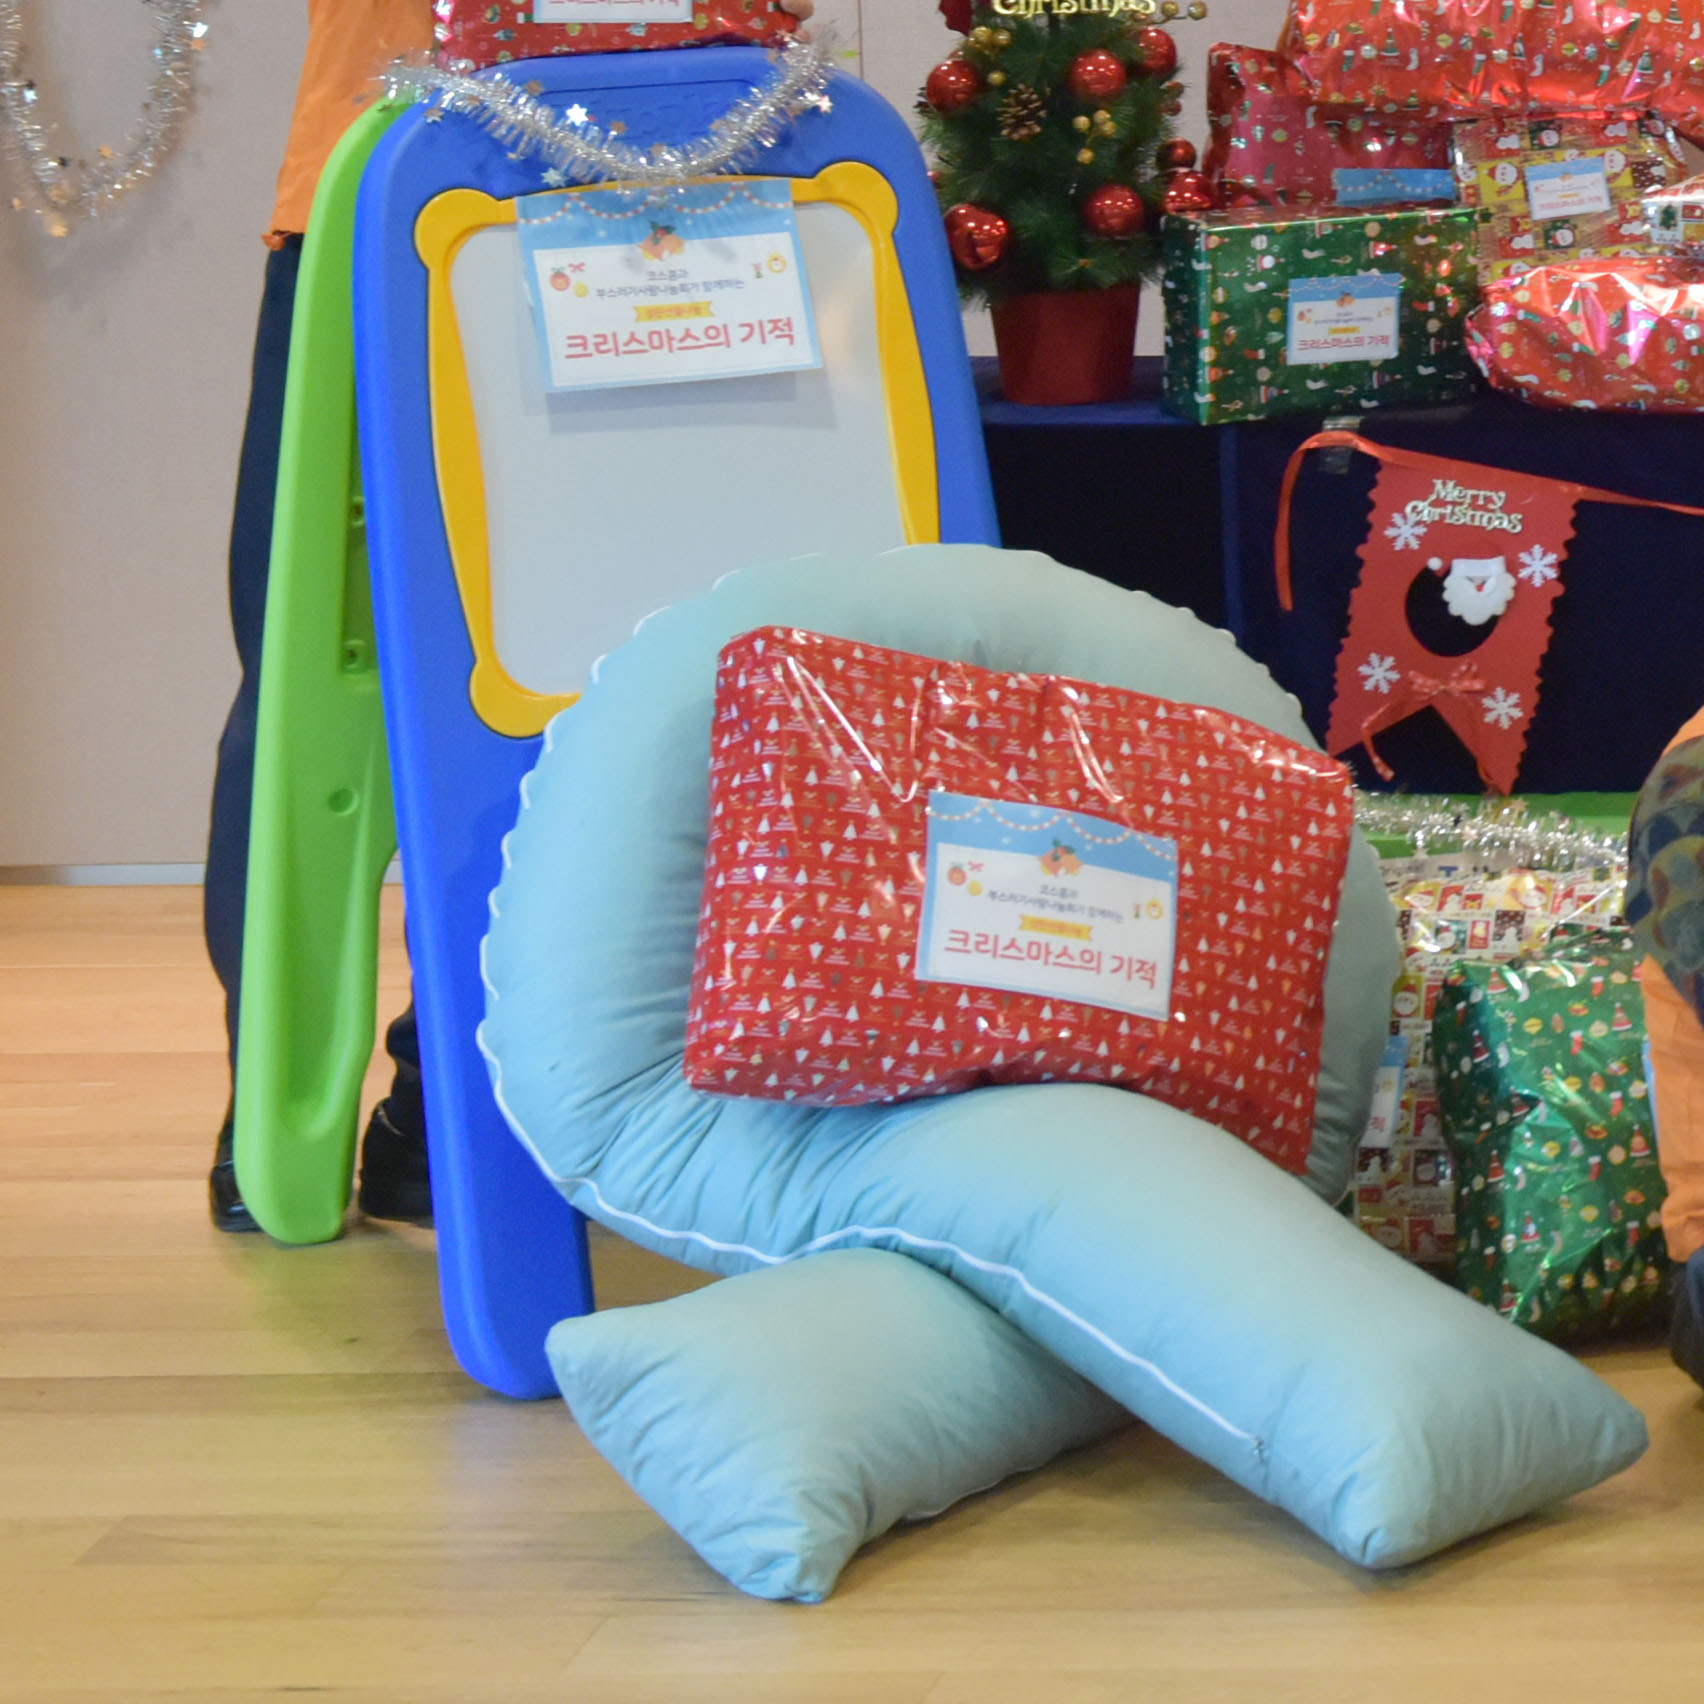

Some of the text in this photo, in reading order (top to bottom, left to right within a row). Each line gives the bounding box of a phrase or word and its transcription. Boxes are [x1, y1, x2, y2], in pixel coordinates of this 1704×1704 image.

[565, 316, 796, 359] 크리스마스의 기적
[1432, 478, 1507, 509] Merry
[945, 928, 1101, 974] 크리스마스의
[1110, 955, 1158, 990] 기적
